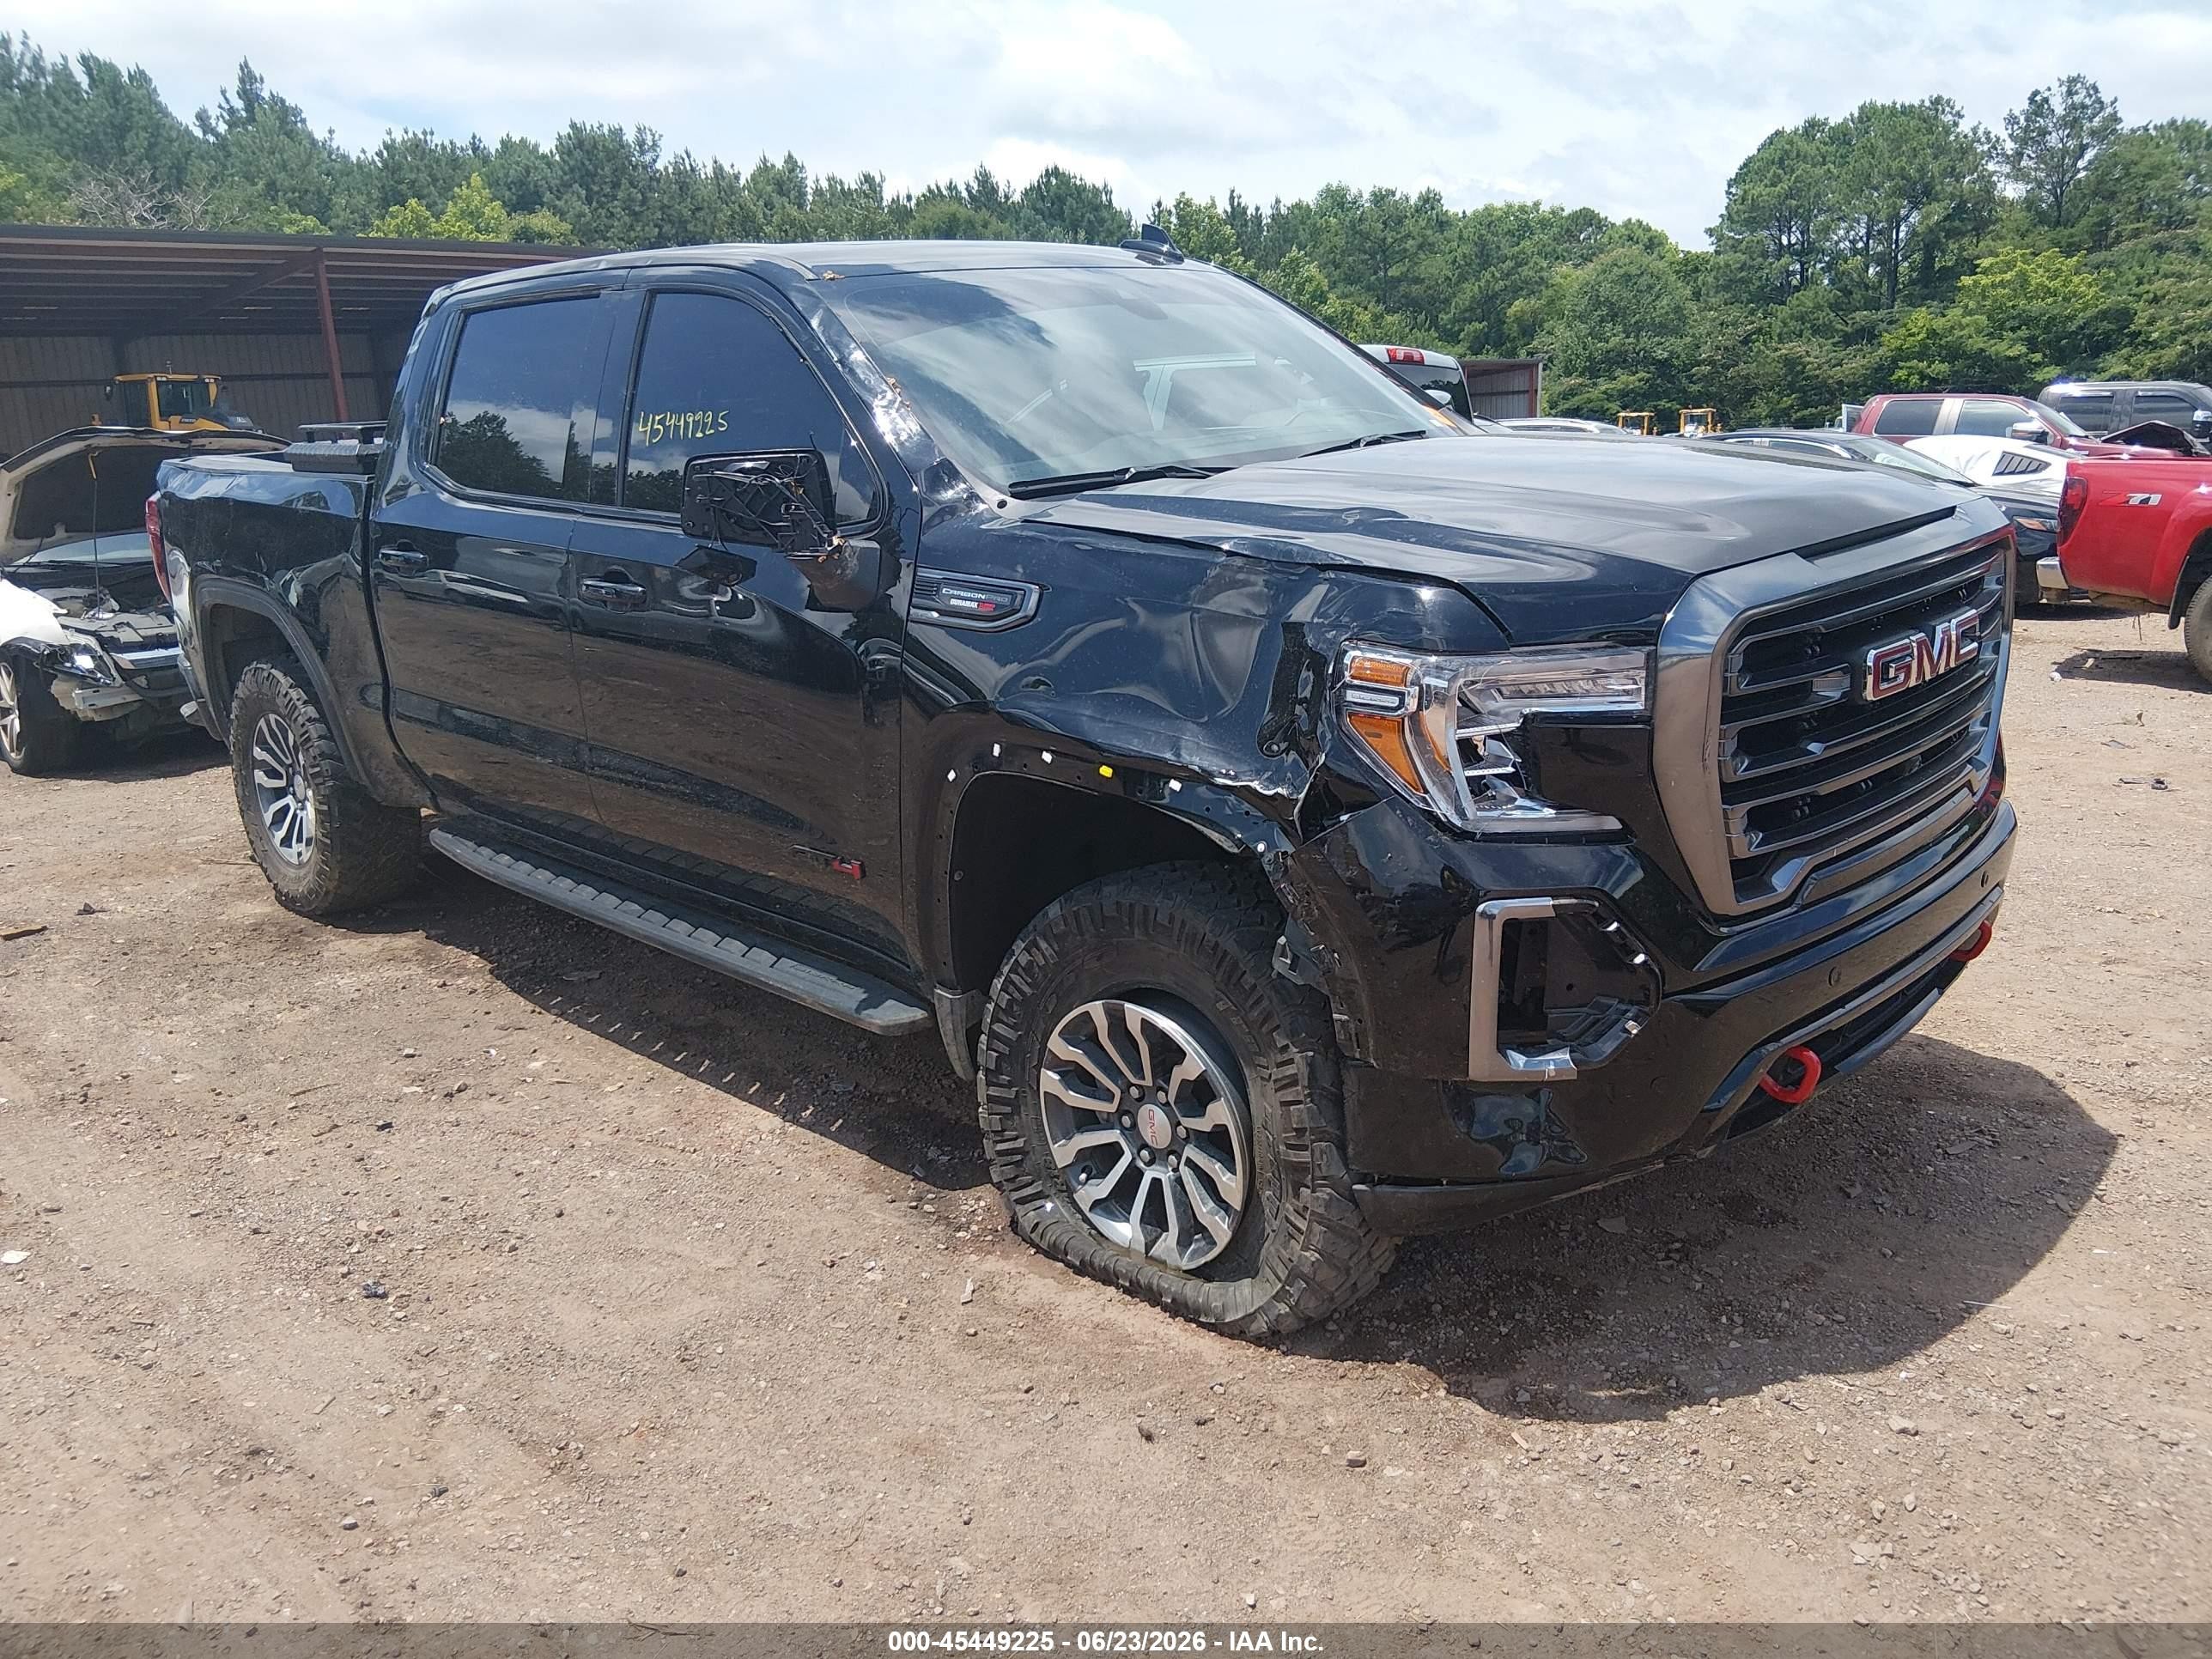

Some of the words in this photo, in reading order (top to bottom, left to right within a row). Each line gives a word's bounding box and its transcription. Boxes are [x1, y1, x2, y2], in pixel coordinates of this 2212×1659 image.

[638, 411, 729, 447] 45449225
[2098, 489, 2163, 507] Z71
[1865, 608, 1980, 702] GMC
[1148, 1109, 1158, 1146] GMC
